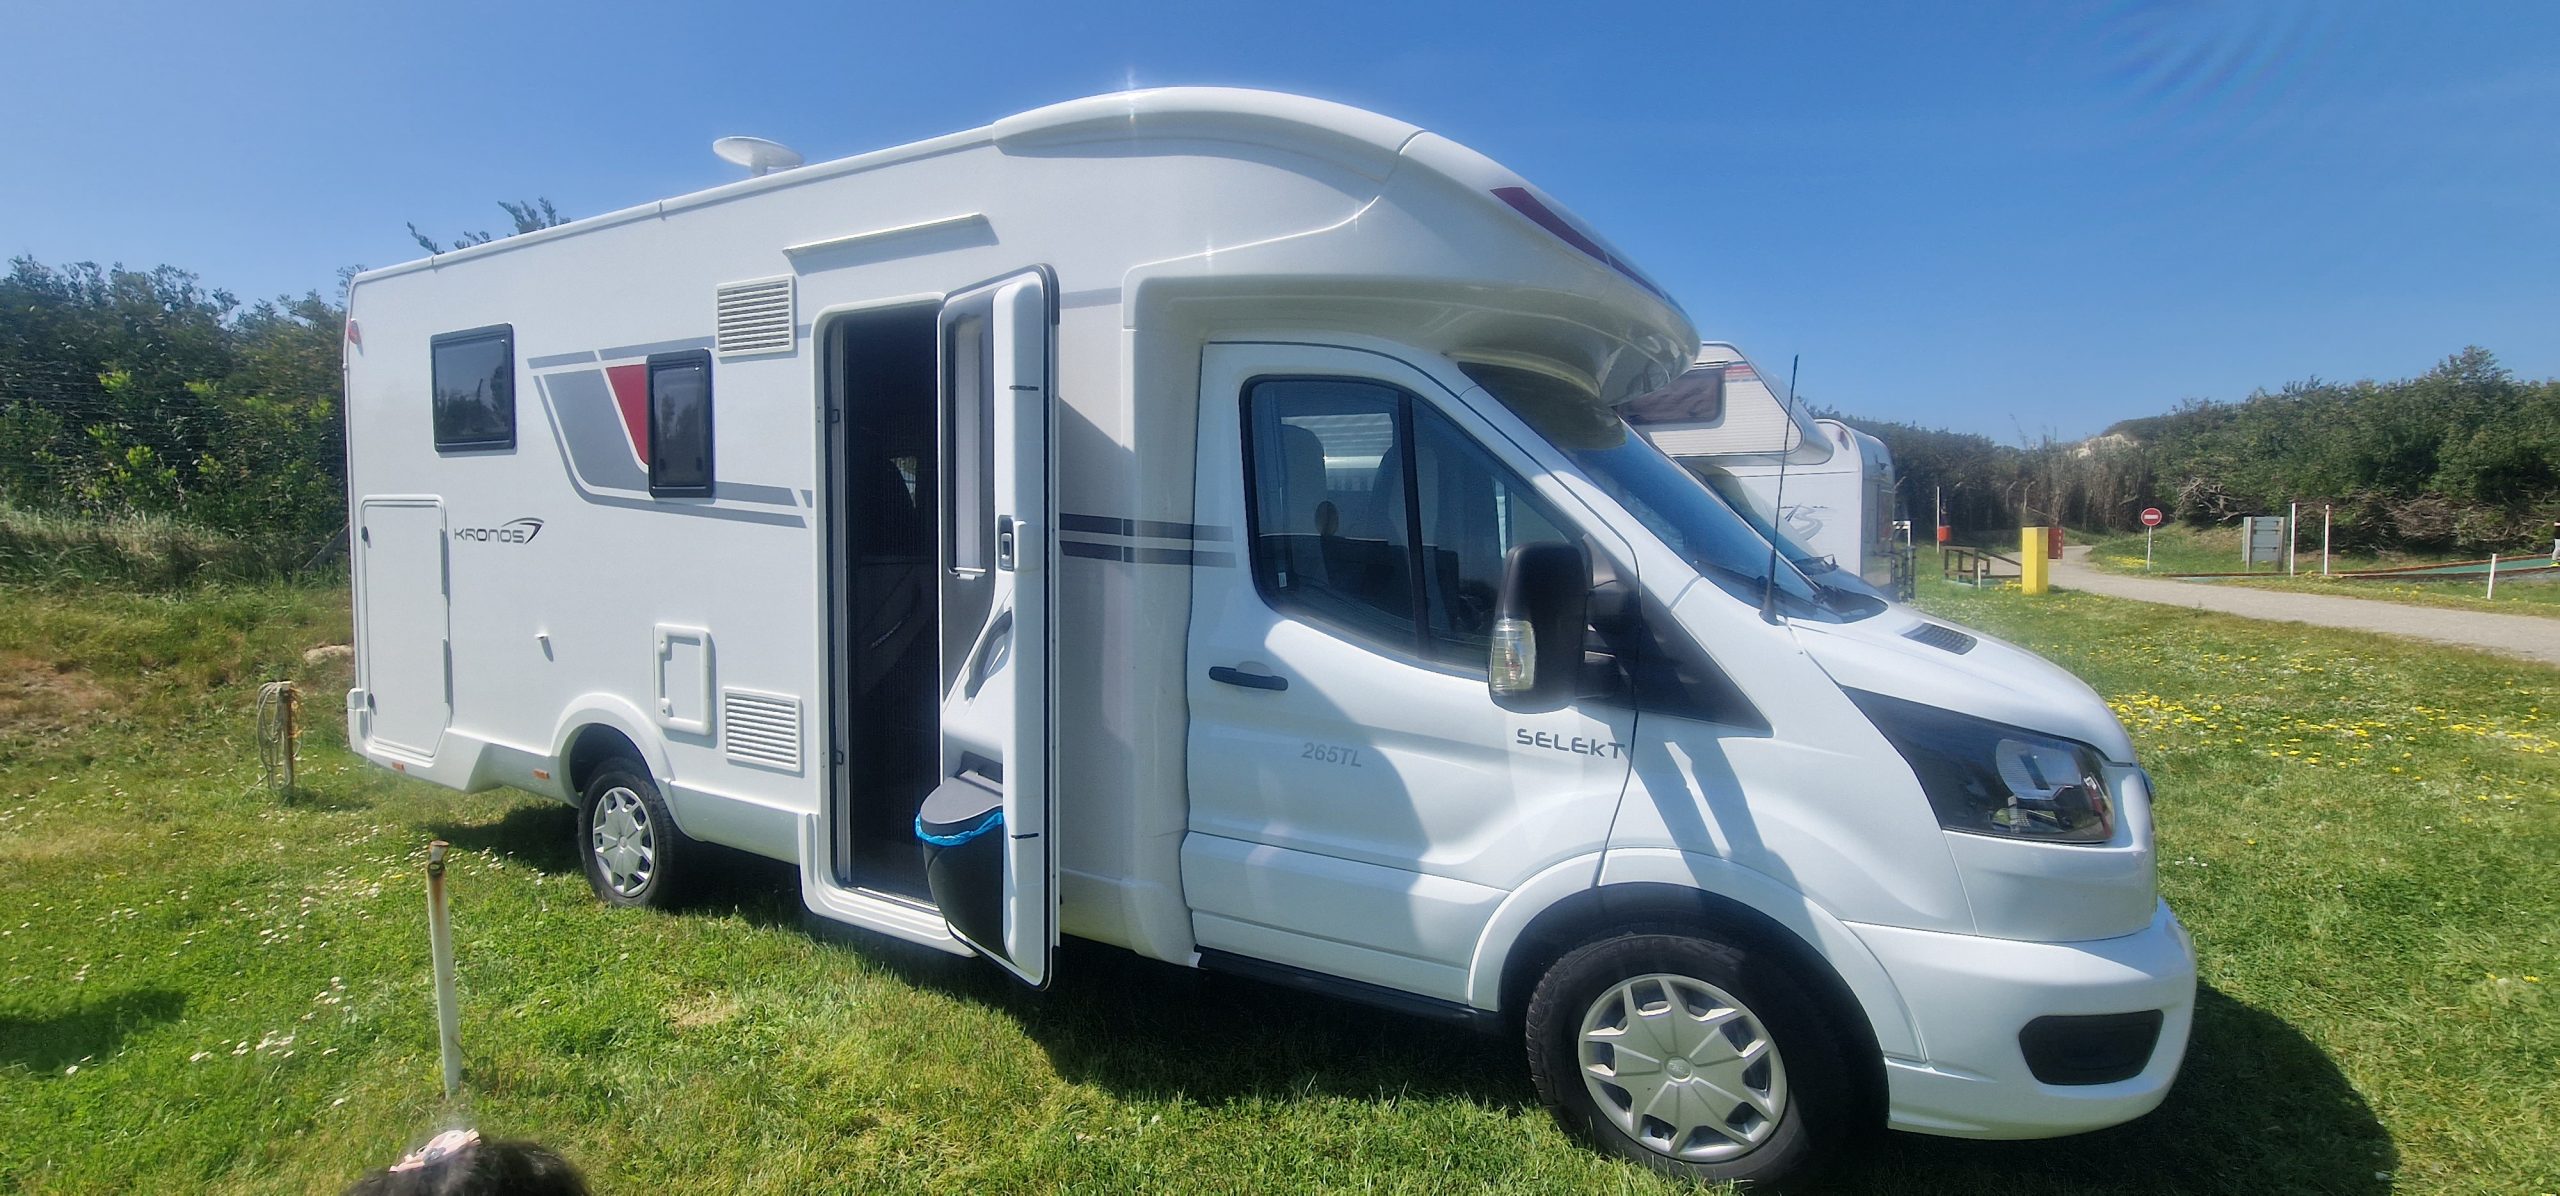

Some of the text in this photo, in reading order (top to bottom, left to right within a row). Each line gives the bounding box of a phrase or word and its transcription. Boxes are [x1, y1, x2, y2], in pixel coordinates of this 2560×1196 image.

[454, 528, 525, 543] KRONOS
[1301, 742, 1362, 769] 265TL
[1516, 728, 1626, 759] SELEKT
